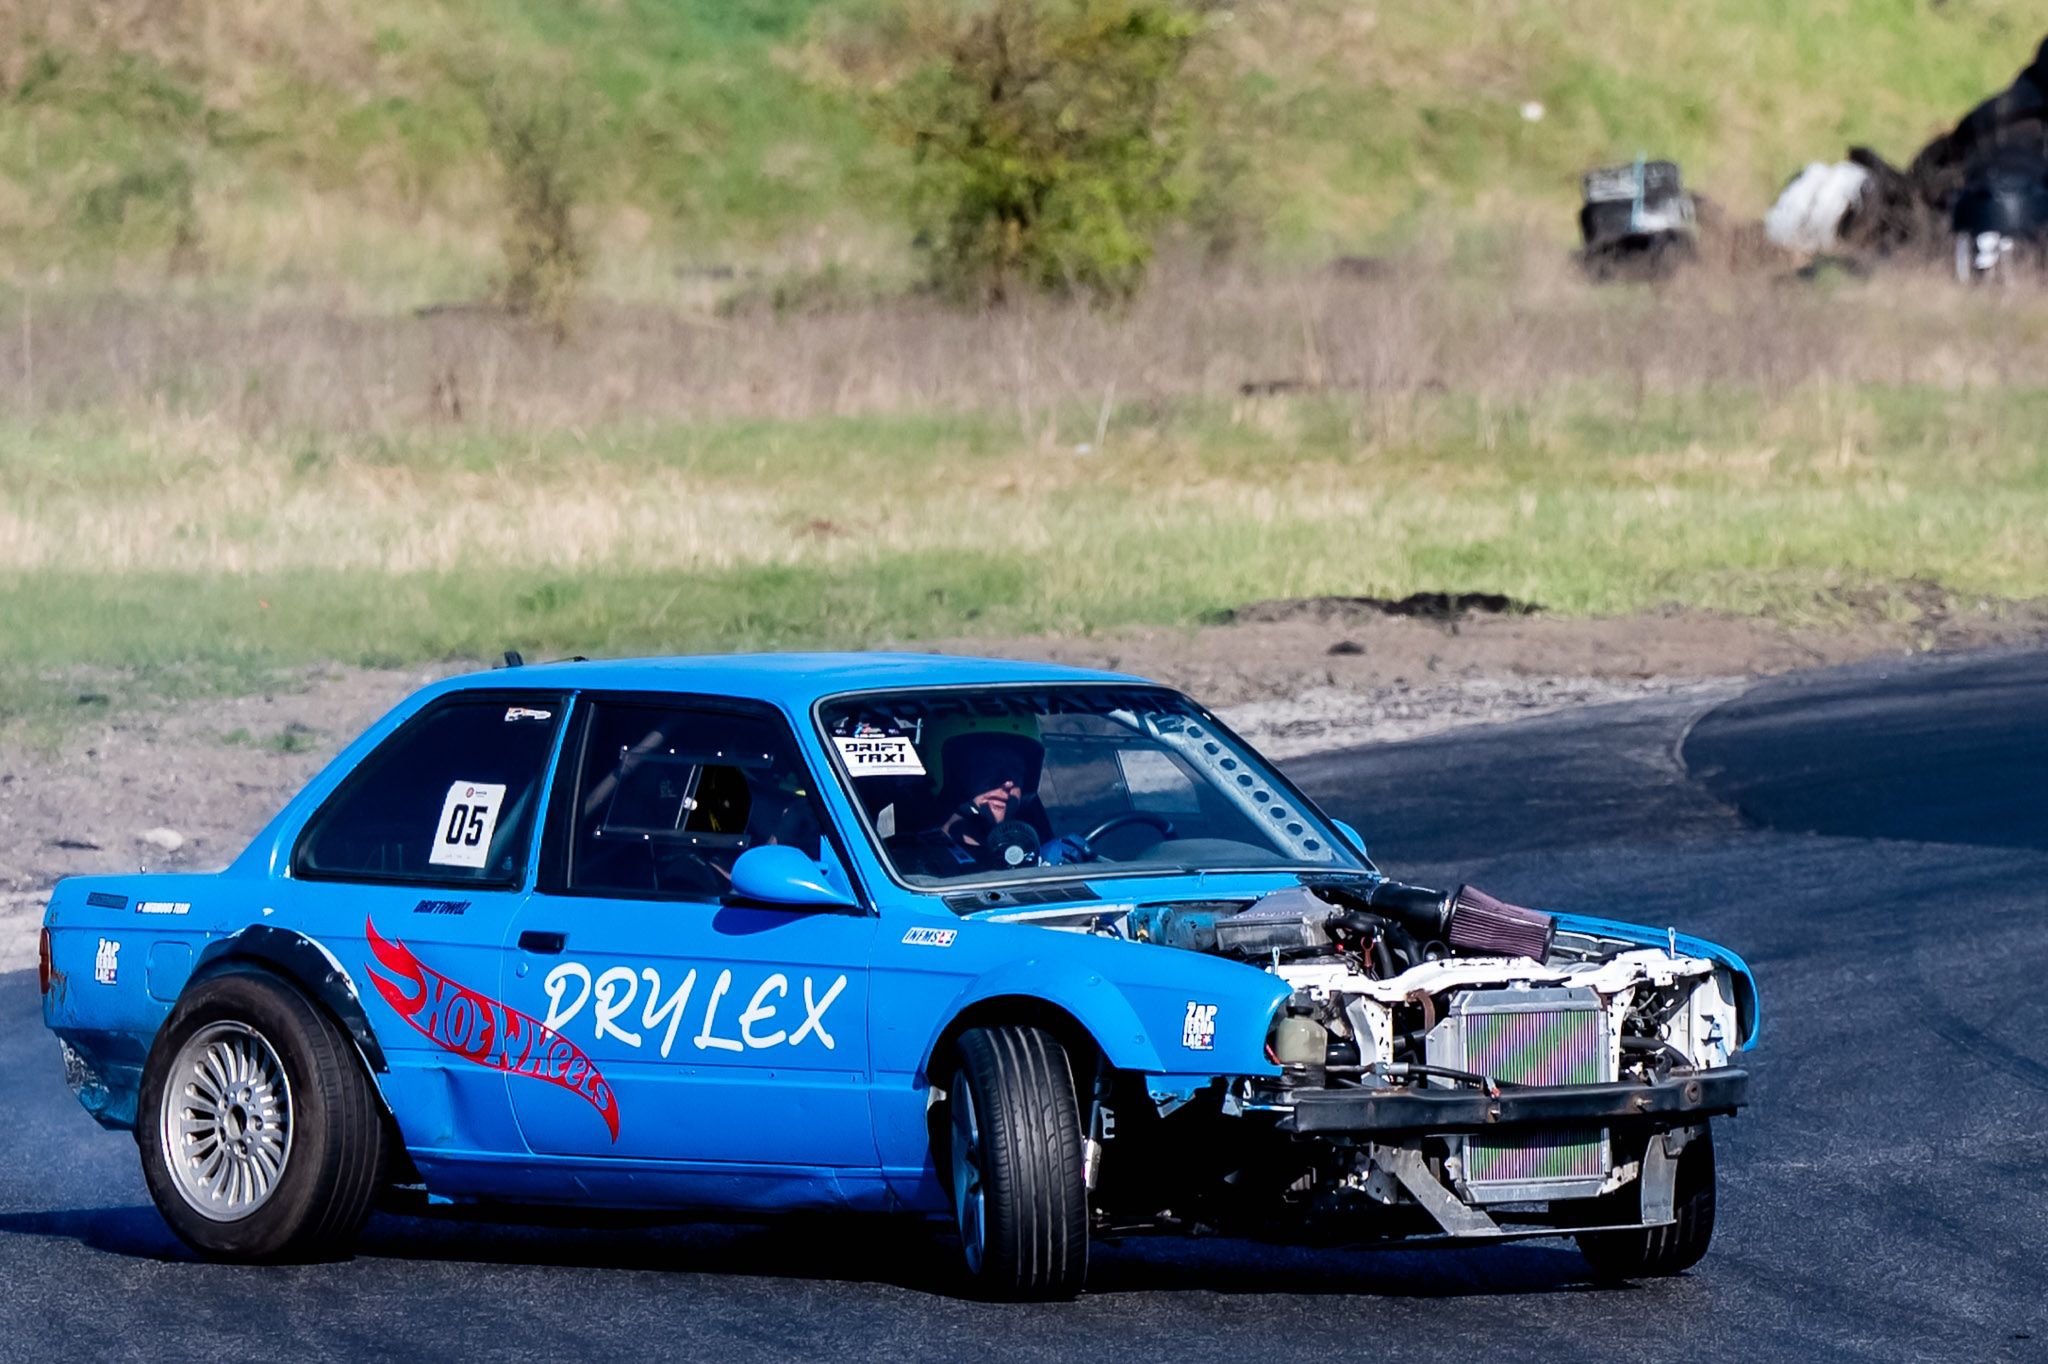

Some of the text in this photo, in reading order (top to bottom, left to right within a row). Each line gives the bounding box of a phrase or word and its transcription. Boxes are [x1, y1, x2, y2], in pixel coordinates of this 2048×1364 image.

[845, 743, 906, 752] DRIFT
[855, 754, 905, 763] TAXI
[446, 803, 488, 846] 05
[97, 938, 120, 957] ZAP
[541, 962, 848, 1058] DRYLEX
[1185, 1001, 1218, 1021] ZAP
